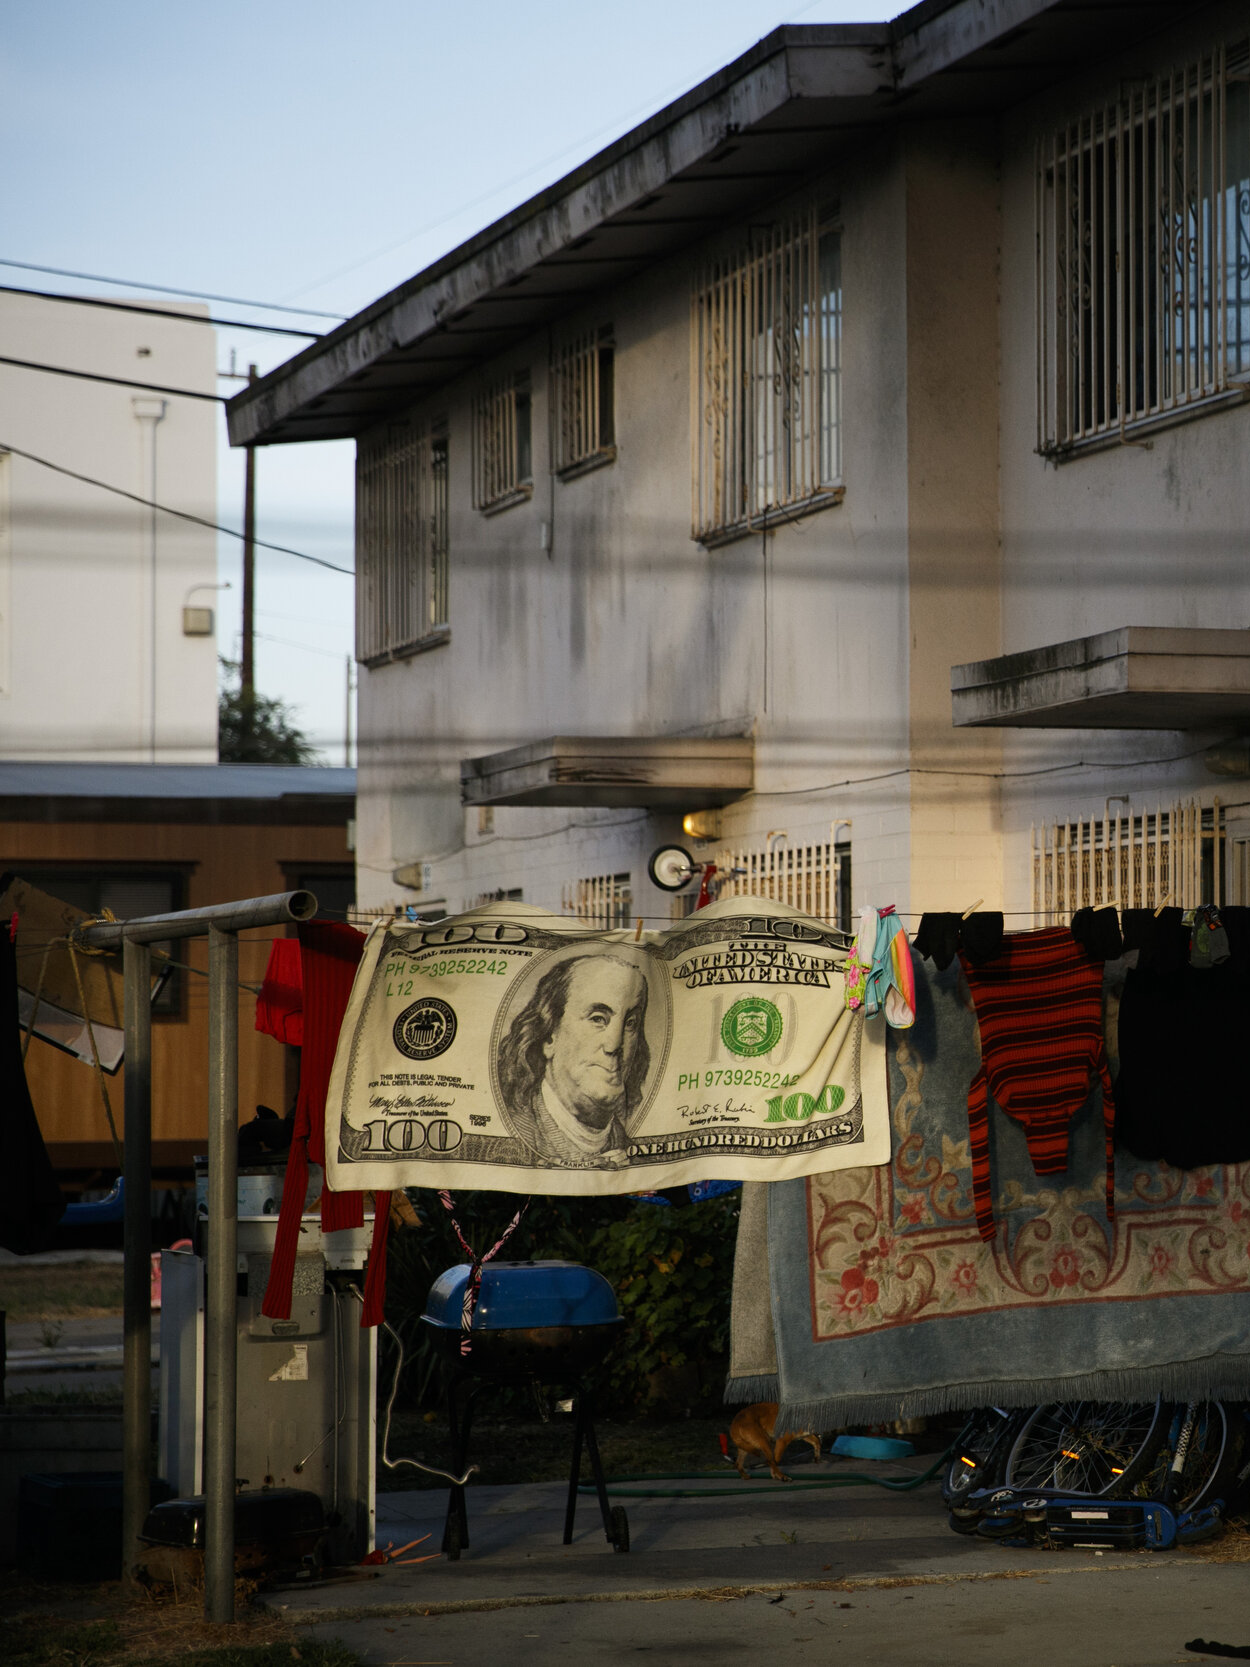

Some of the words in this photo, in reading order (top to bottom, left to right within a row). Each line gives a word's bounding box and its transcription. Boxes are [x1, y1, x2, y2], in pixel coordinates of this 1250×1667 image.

[440, 947, 497, 955] RESERVE
[499, 948, 534, 957] NOTE
[384, 961, 406, 978] PH
[715, 967, 831, 988] AMERICA
[405, 1001, 430, 1018] UNITED
[430, 1001, 450, 1017] STATES
[407, 1047, 437, 1057] RESERVE
[437, 1021, 453, 1050] SYSTEM
[437, 1075, 462, 1083] TENDER
[448, 1082, 475, 1090] PRIVATE
[678, 1072, 699, 1092] PH
[763, 1084, 846, 1123] 100
[362, 1119, 463, 1154] 100
[628, 1143, 664, 1158] ONE
[665, 1134, 760, 1153] HUNDRED
[760, 1121, 853, 1149] DOLLARS
[560, 1160, 595, 1168] FRANKLIN
